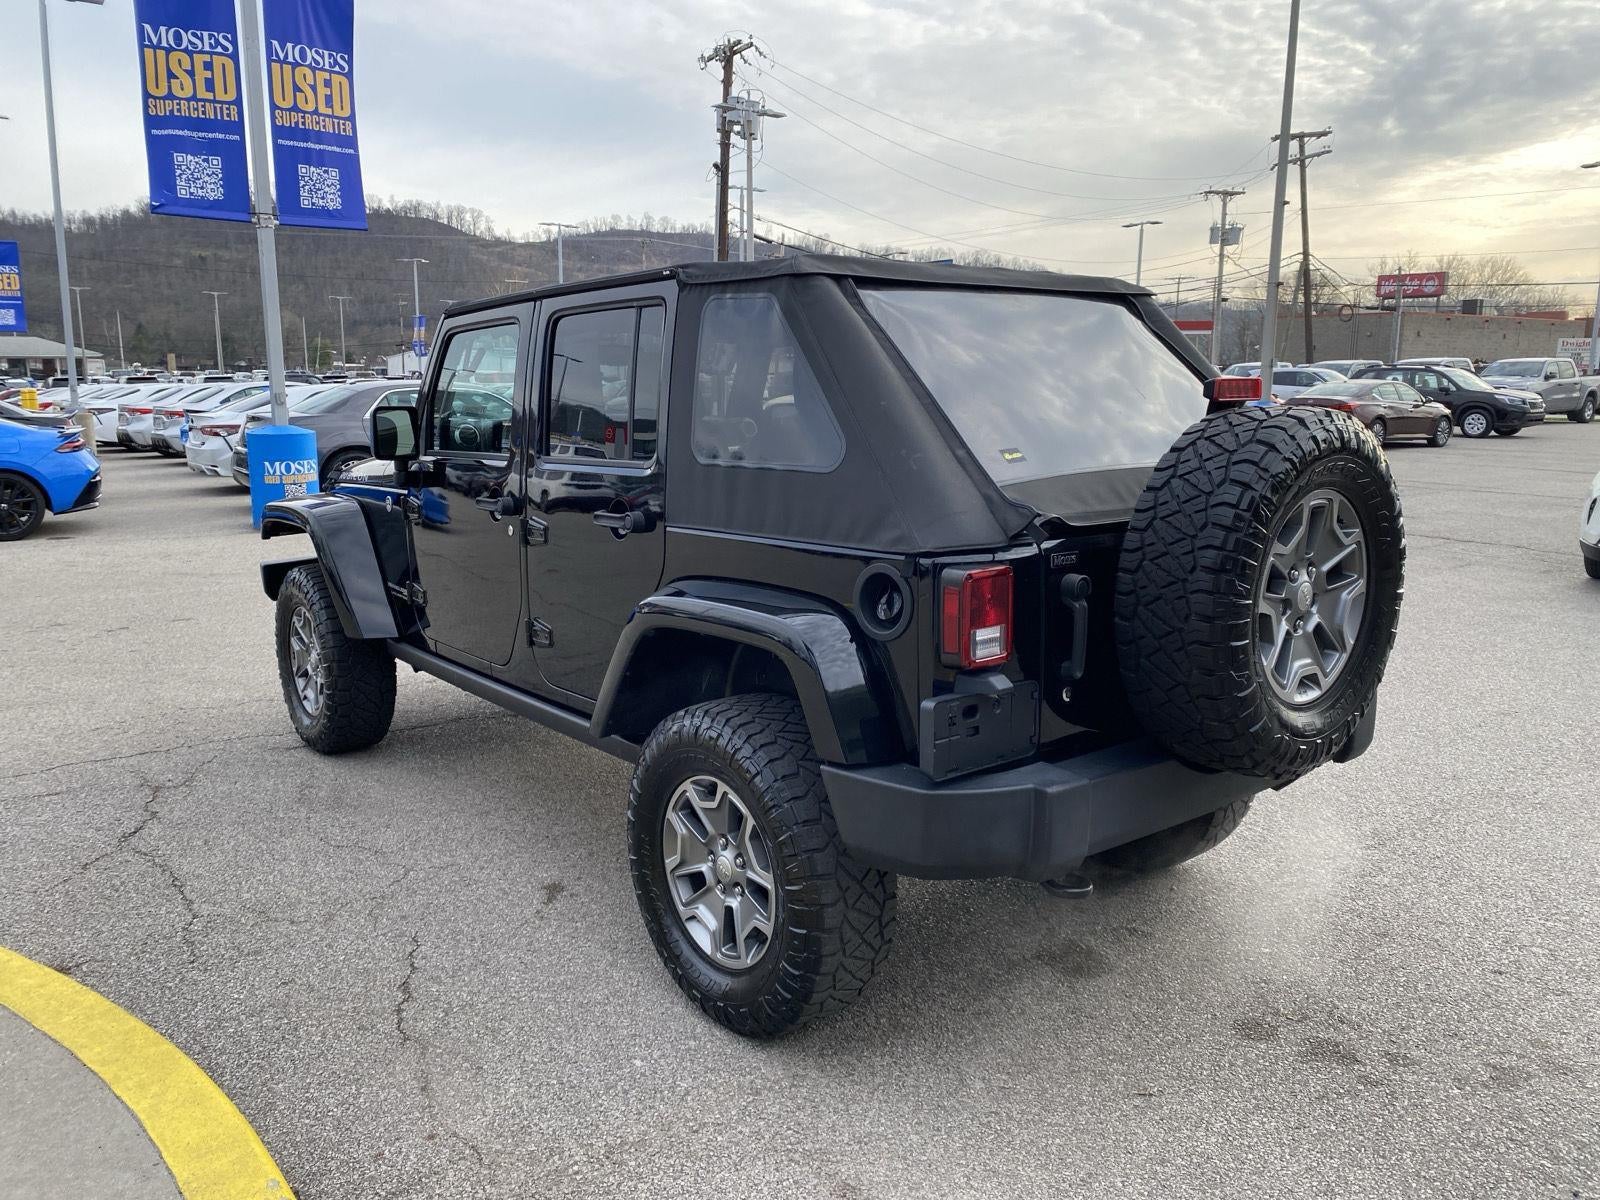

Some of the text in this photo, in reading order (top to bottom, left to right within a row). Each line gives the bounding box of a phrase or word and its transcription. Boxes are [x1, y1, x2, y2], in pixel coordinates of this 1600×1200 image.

[141, 23, 233, 53] MOSES
[270, 39, 349, 73] MOSES
[144, 48, 237, 101] USED
[271, 62, 351, 117] USED
[148, 99, 238, 122] SUPERCENTER
[151, 128, 240, 141] mosesusedsupercenter.com
[275, 110, 353, 136] SUPERCENTER
[277, 138, 355, 154] mosesusedsupercenter.com
[1380, 276, 1420, 294] Wedy's
[263, 459, 317, 476] MOSES
